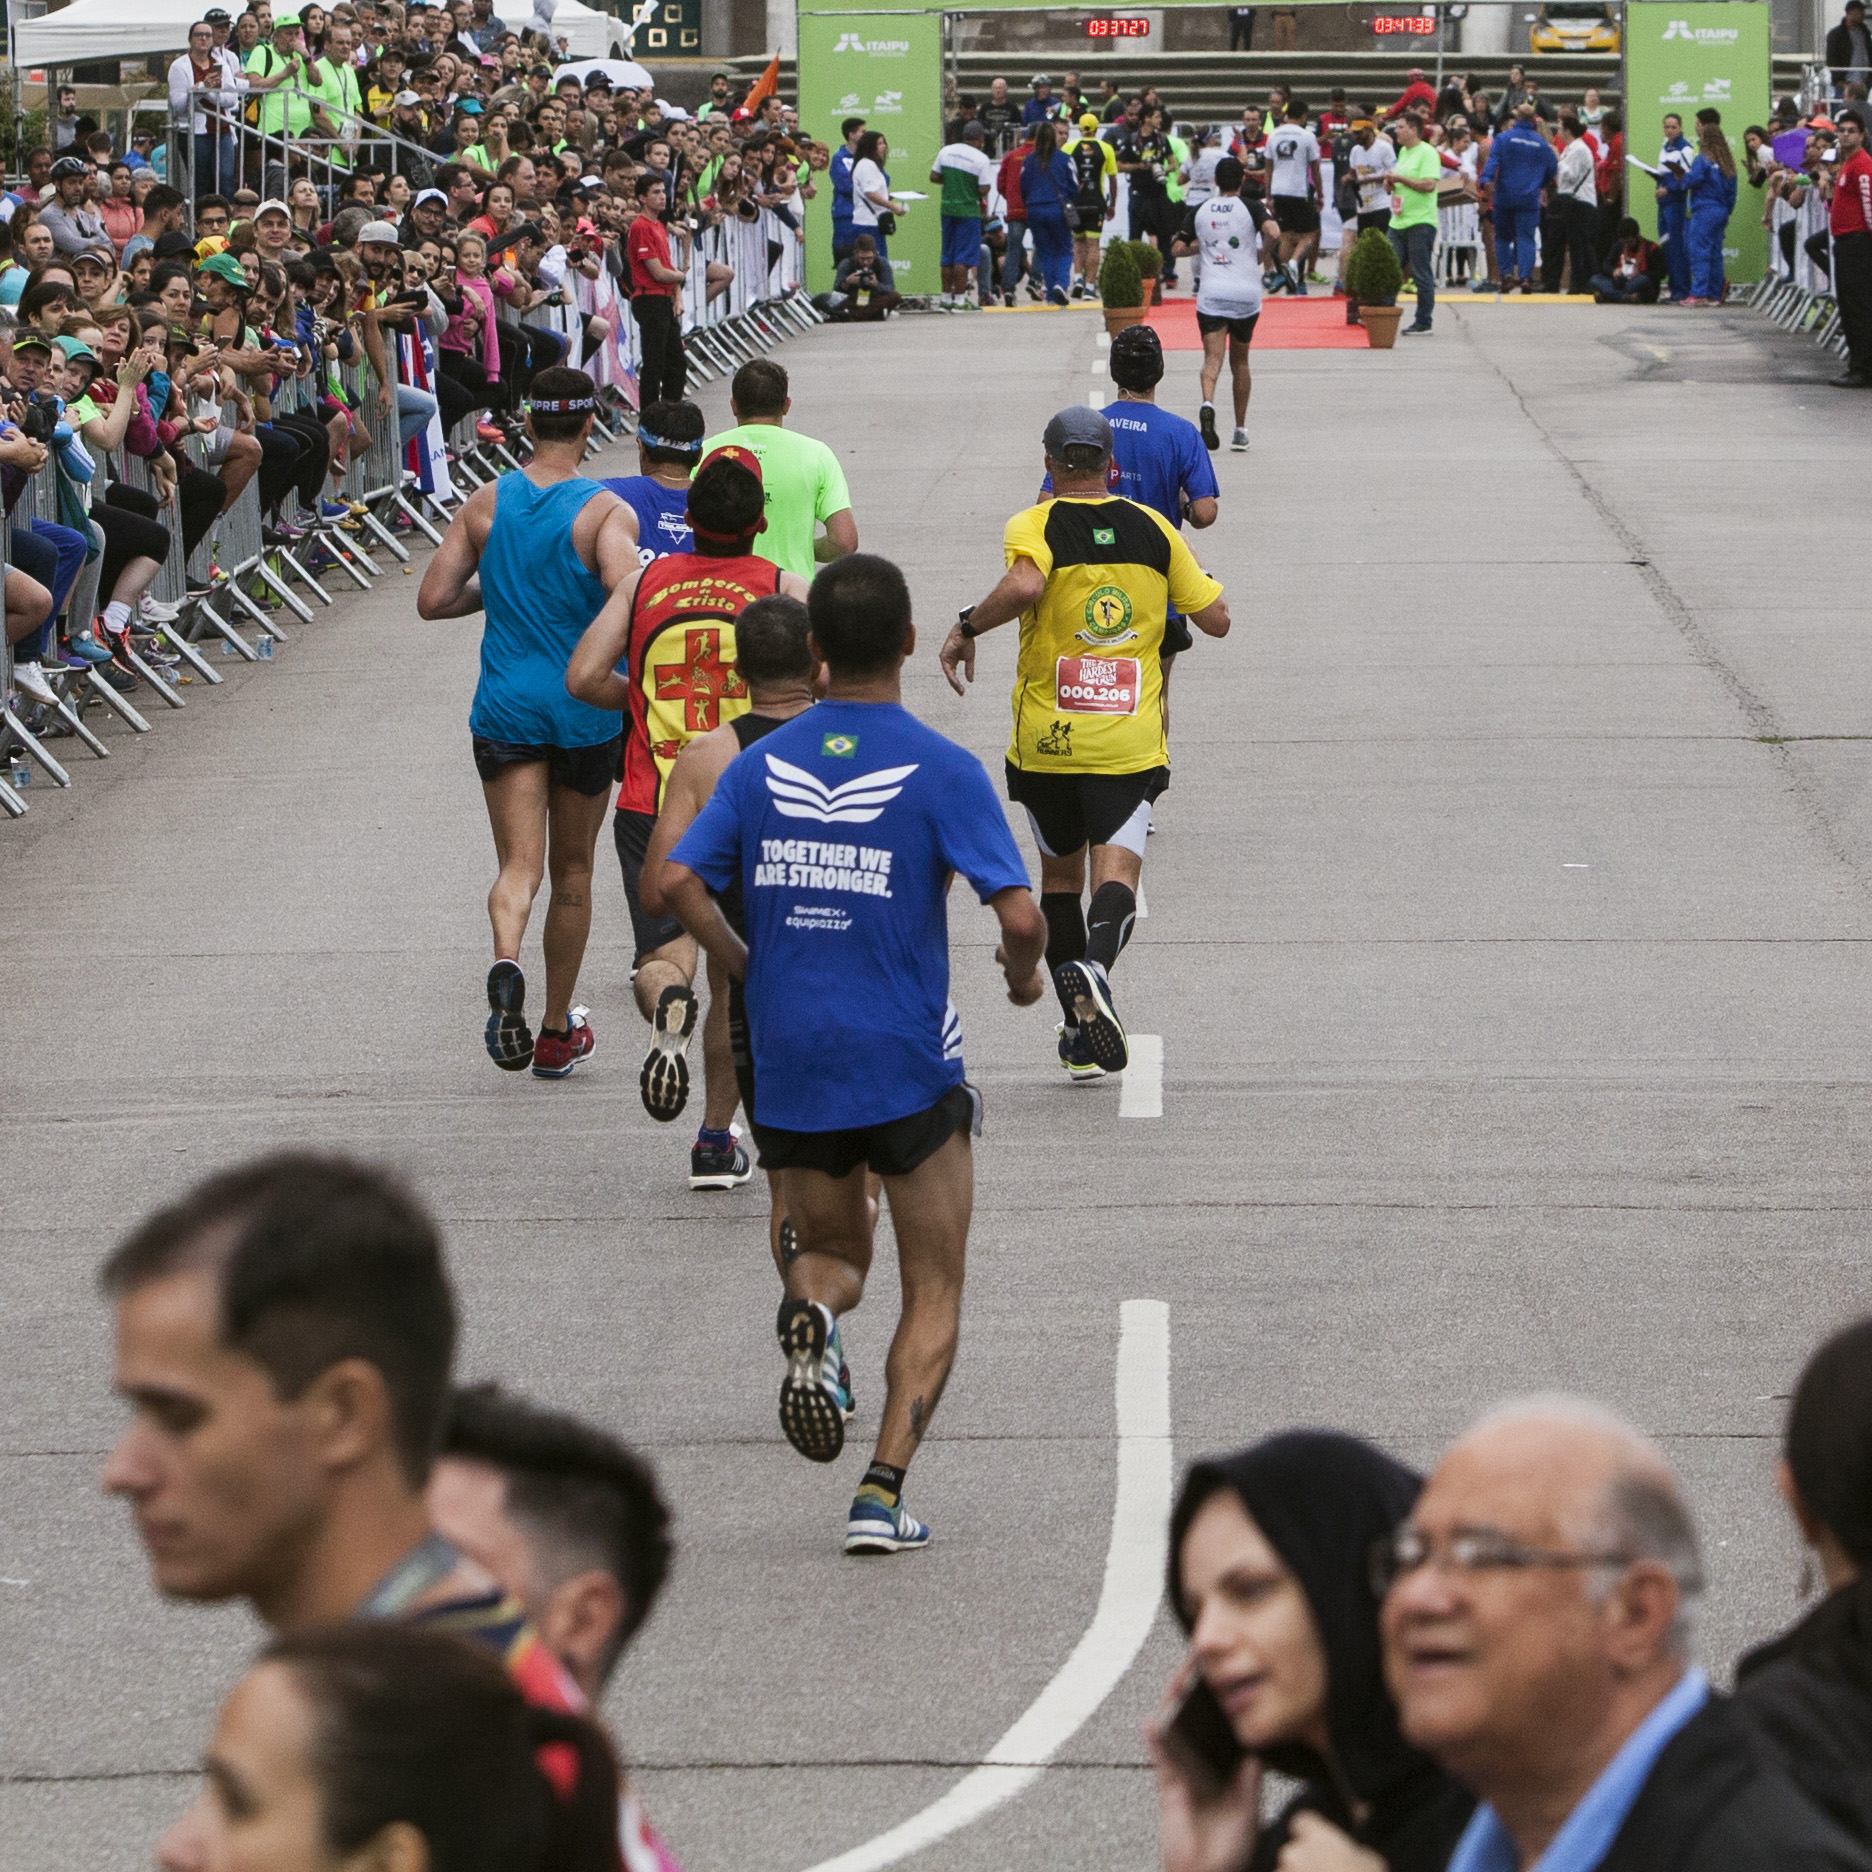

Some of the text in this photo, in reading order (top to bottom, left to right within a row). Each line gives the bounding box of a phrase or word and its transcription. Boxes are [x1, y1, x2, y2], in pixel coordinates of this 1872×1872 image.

[1695, 28, 1738, 39] ITAIPU
[866, 41, 909, 52] ITAIPU
[1079, 661, 1118, 682] HARDEST
[1060, 685, 1131, 701] 000.206
[761, 839, 893, 874] TOGETHER WE
[754, 863, 893, 898] ARE STRONGER.
